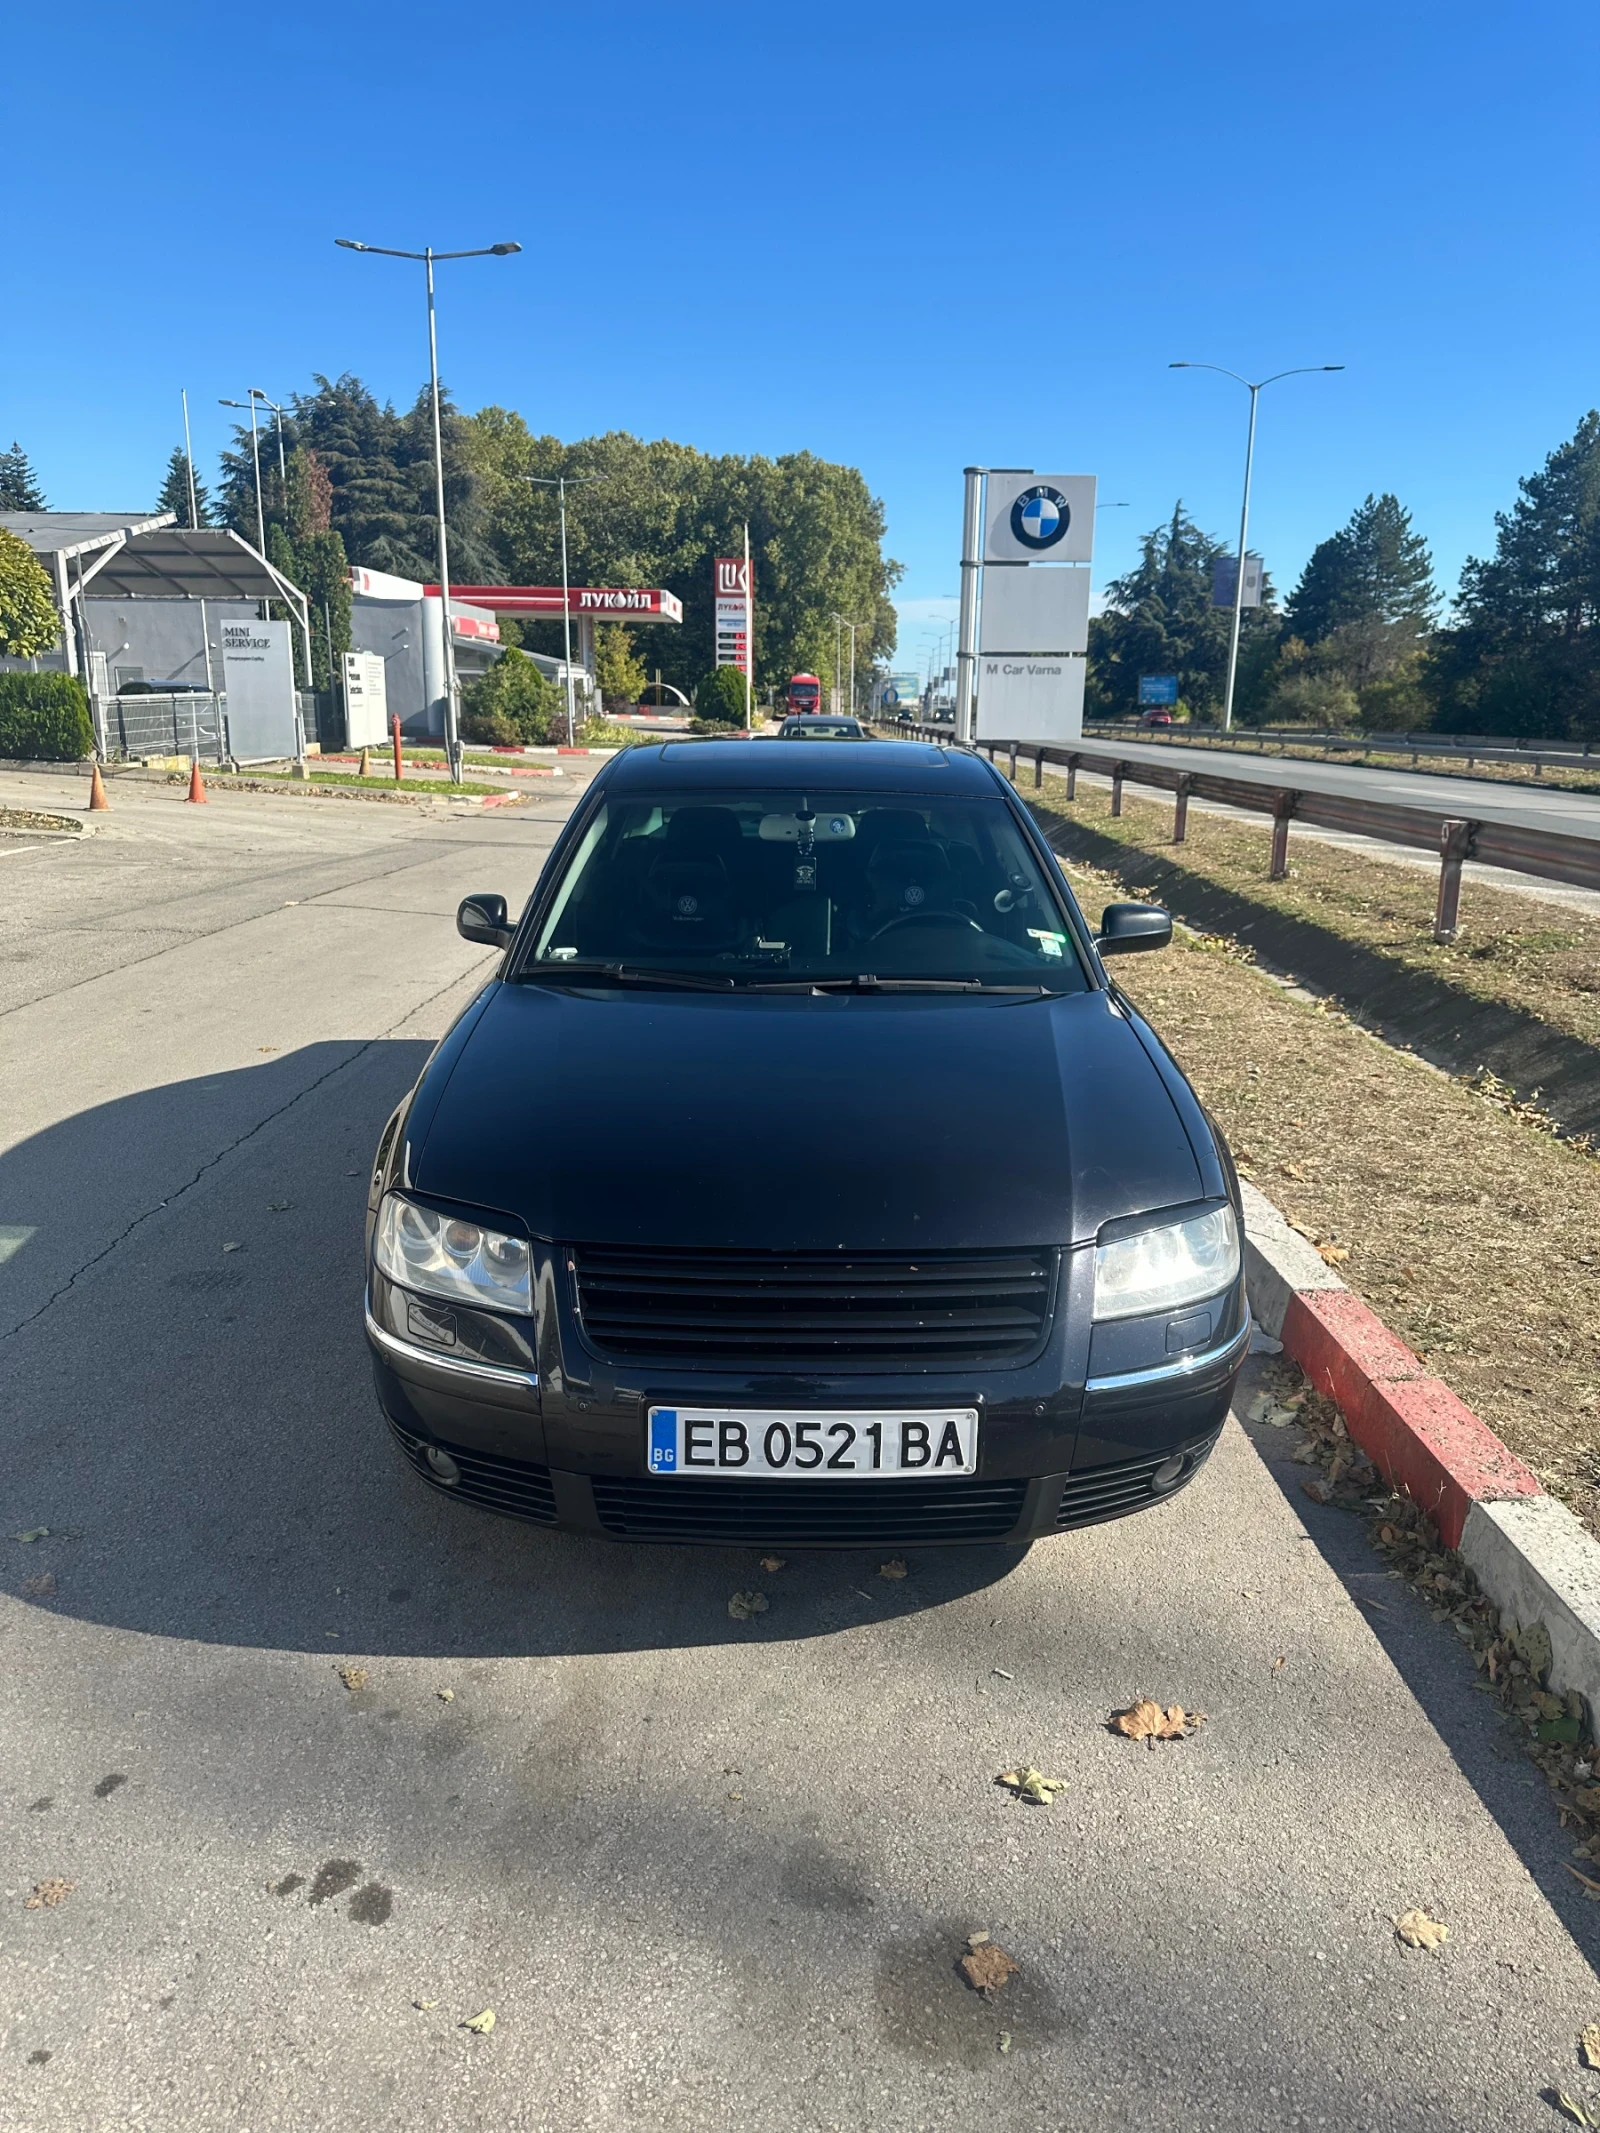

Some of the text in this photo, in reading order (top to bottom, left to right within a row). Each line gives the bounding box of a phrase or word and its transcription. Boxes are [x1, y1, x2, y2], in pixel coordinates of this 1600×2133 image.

[1017, 486, 1069, 509] BMW
[225, 627, 250, 637] MINI
[225, 638, 271, 648] SERVICE
[986, 664, 1062, 675] M Car Varna
[684, 1419, 965, 1469] EB 0521 BA
[653, 1448, 674, 1462] BG
